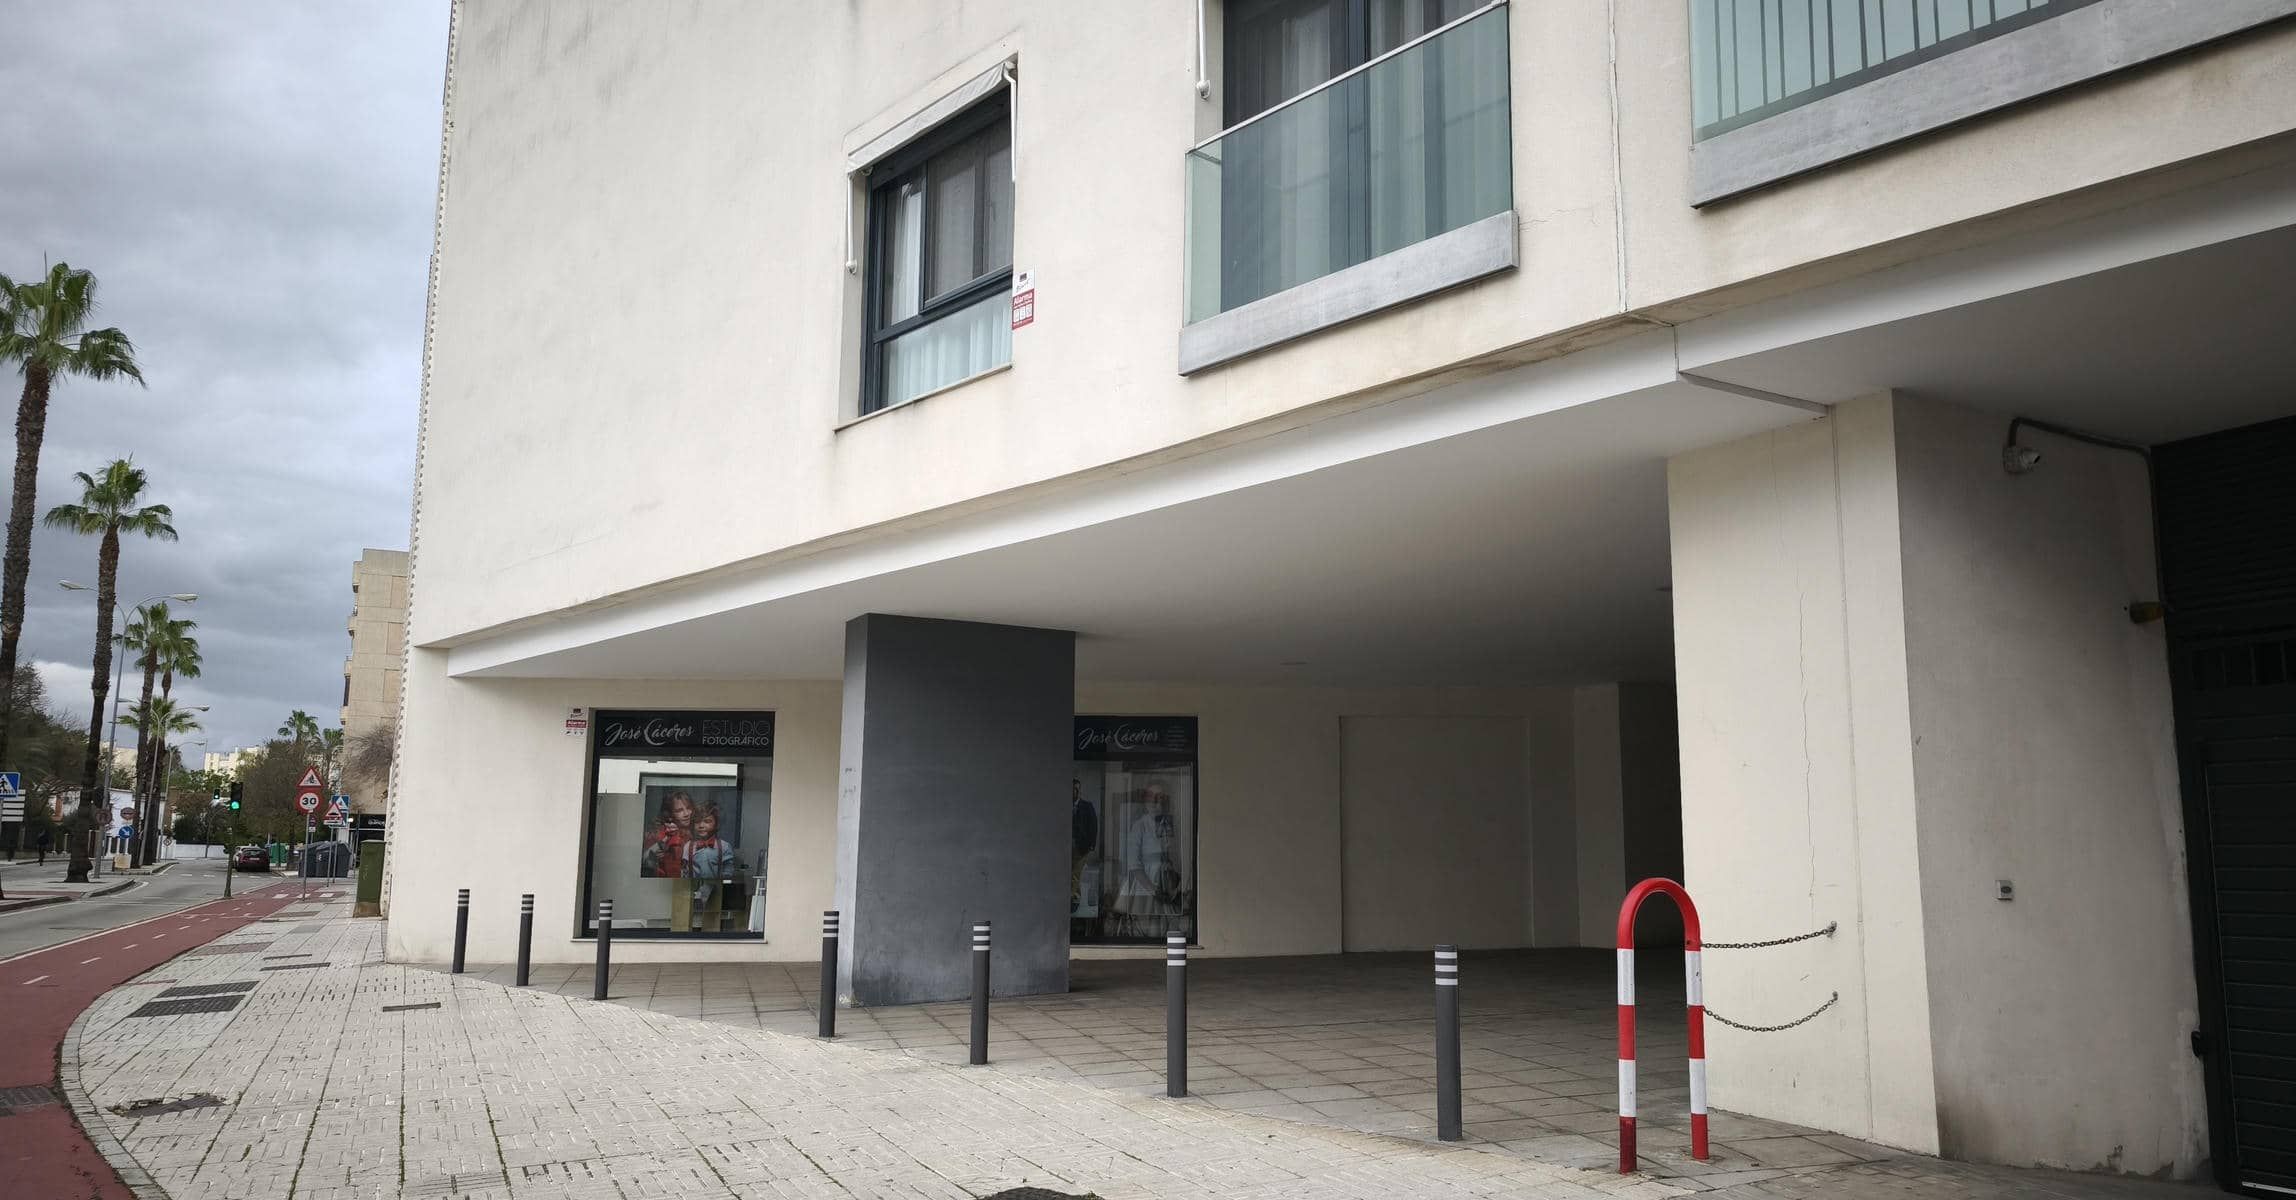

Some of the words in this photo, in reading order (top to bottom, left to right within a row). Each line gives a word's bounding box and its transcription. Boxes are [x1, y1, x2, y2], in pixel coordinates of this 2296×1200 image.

[604, 722, 641, 746] José
[643, 718, 694, 746] Cáceres
[702, 719, 771, 735] ESTUDIO
[302, 797, 317, 805] 30
